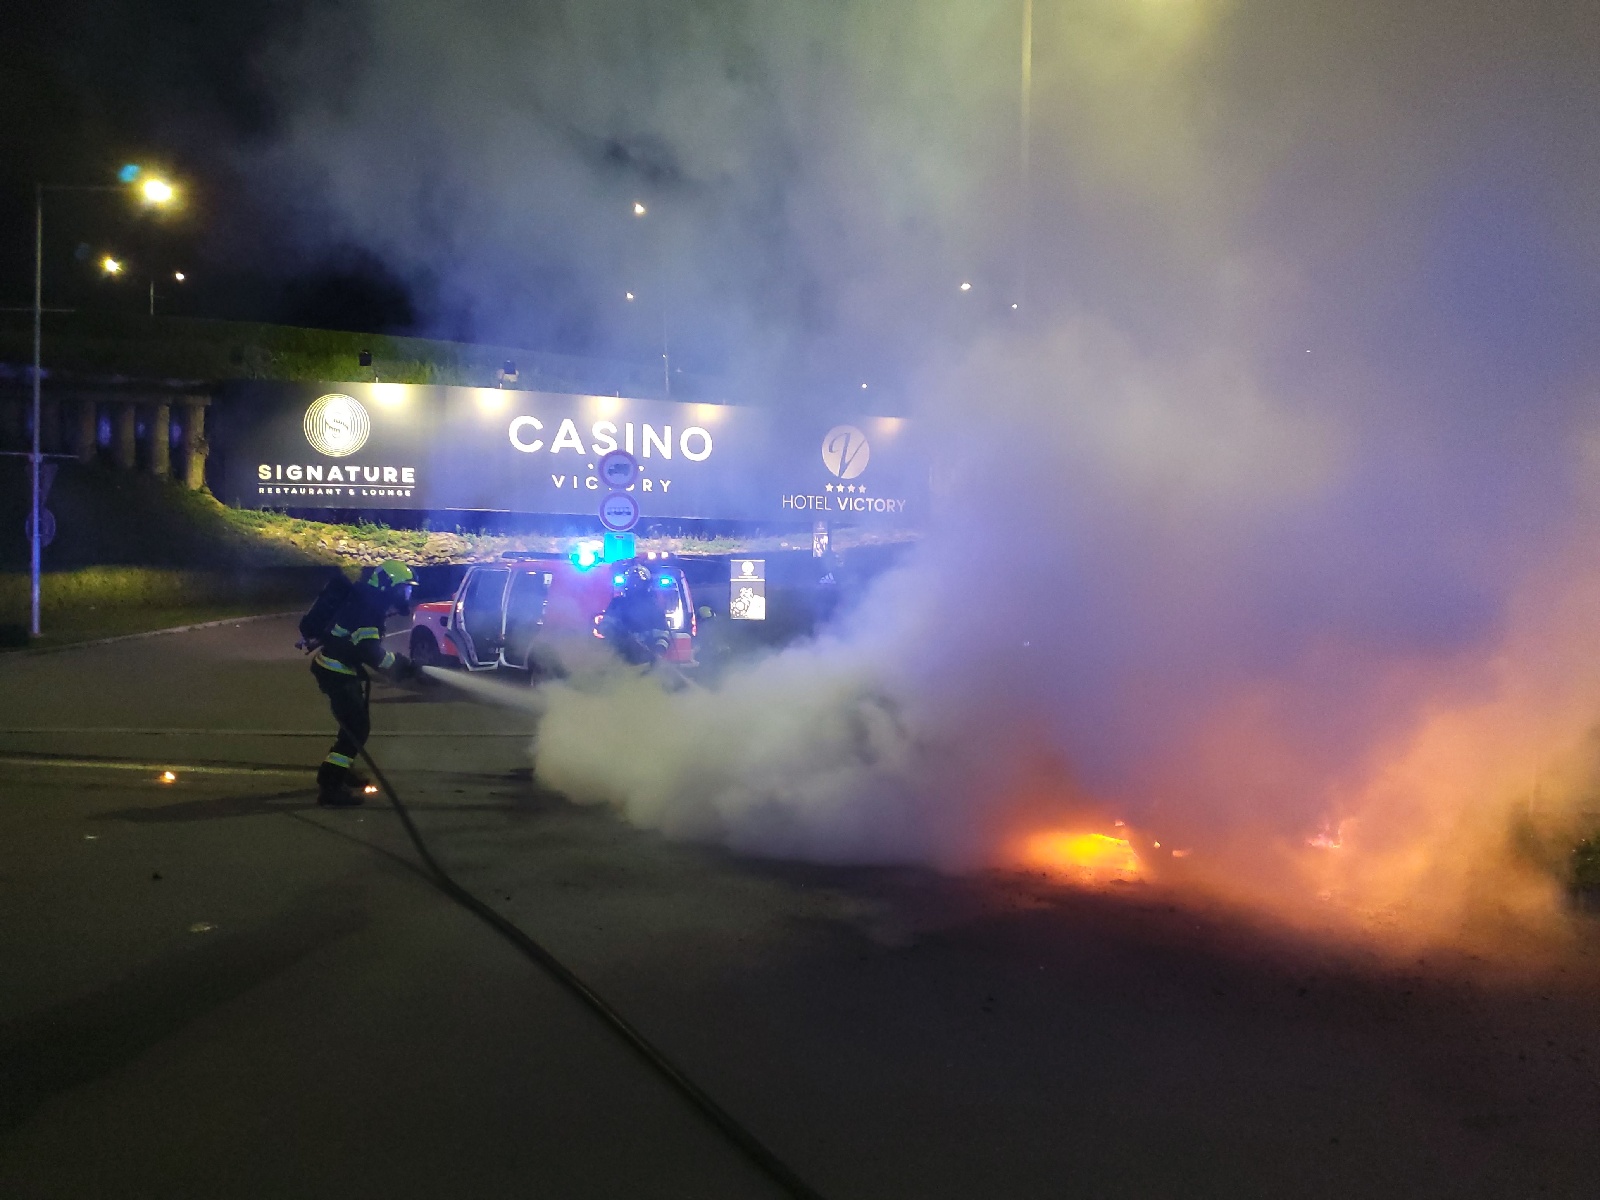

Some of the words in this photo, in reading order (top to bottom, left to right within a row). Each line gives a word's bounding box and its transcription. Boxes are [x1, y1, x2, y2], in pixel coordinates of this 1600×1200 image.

[508, 415, 713, 462] CASINO
[258, 464, 415, 483] SIGNATURE
[551, 474, 672, 492] VICRY
[258, 487, 341, 496] RESTAURANT
[362, 489, 411, 497] LOUNGE
[782, 494, 832, 511] HOTEL
[837, 496, 906, 513] VICTORY
